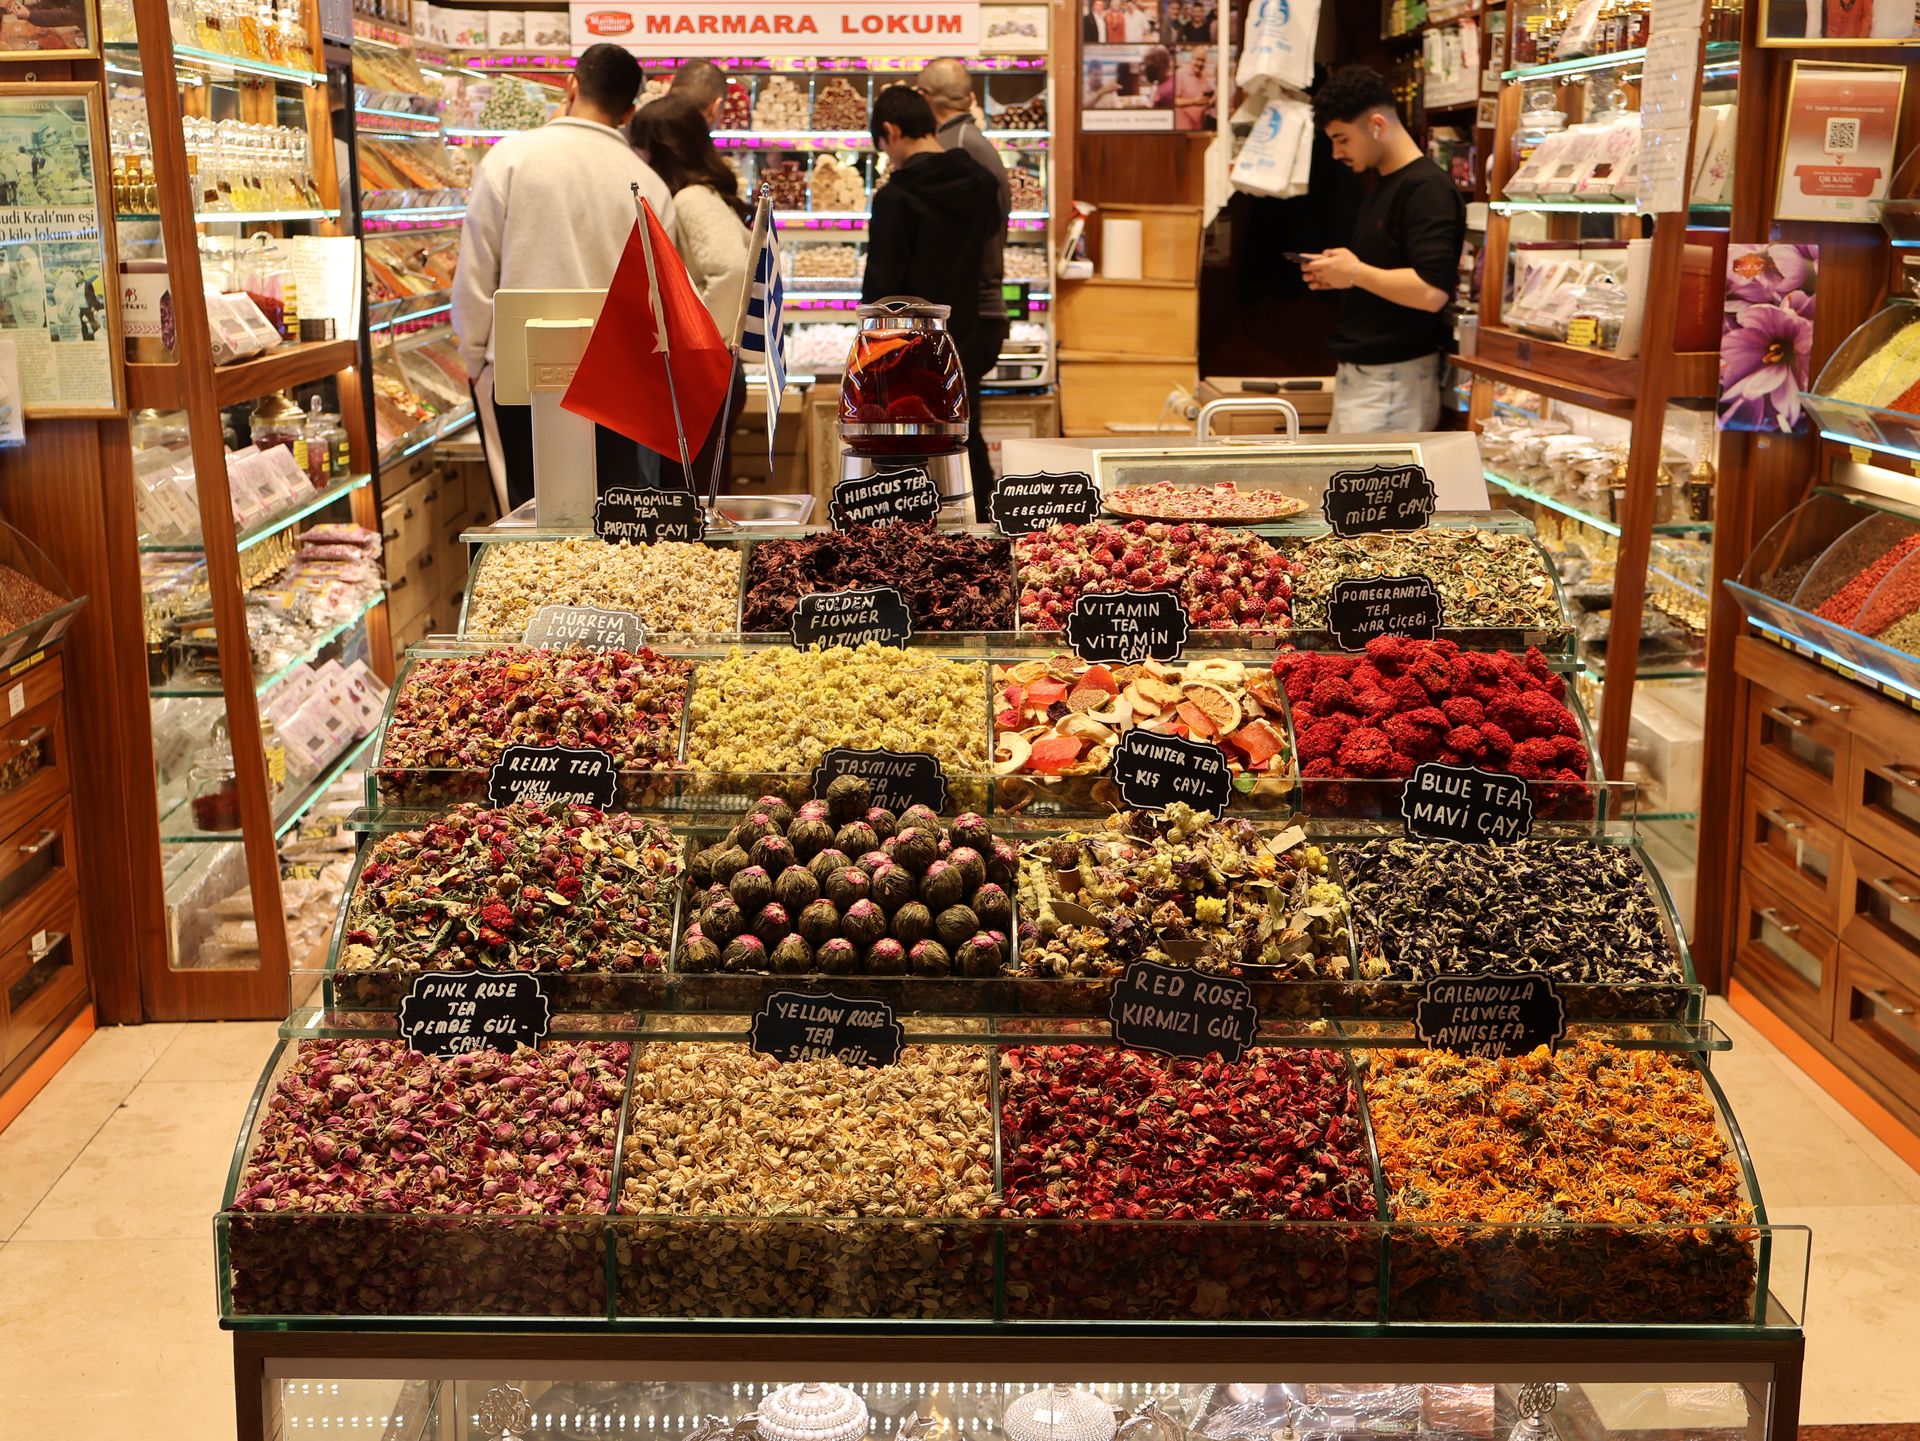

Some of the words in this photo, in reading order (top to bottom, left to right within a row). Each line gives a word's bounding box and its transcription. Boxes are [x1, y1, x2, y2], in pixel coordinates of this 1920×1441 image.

[646, 15, 818, 34] MARMARA
[841, 15, 962, 34] LOKUM
[9, 228, 31, 241] kilo
[35, 227, 73, 241] lokum
[844, 479, 901, 505] HIBISCUS
[903, 475, 927, 491] TEA
[1003, 483, 1054, 496] MALLOW
[1060, 483, 1083, 494] TEA
[1339, 472, 1411, 493] STOMACH
[1365, 490, 1394, 505] TEA
[634, 507, 659, 519] TEA
[603, 521, 648, 538] PAPATYA
[815, 595, 876, 612] GOLDEN
[1342, 585, 1429, 603] POMEGRANATE
[1083, 601, 1160, 618] VITAMIN
[1366, 603, 1390, 617] TEA
[810, 610, 879, 629] FLOWER
[1111, 619, 1139, 632] TEA
[546, 625, 590, 639] LOVE
[596, 630, 626, 645] TEA
[509, 757, 560, 772] RELAX
[569, 760, 602, 777] TEA
[1131, 741, 1186, 766] WINTER
[1193, 756, 1219, 775] TEA
[835, 759, 917, 777] JASMINE
[1421, 773, 1472, 798] BLUE
[1482, 783, 1521, 810] TEA
[1477, 812, 1519, 838] ÇAY
[422, 982, 467, 999] PINK
[474, 982, 517, 999] ROSE
[1135, 970, 1185, 997] RED
[1193, 982, 1247, 1011] ROSE
[1433, 982, 1534, 1004] CALENDULA
[448, 1001, 477, 1016] TEA
[776, 1002, 844, 1025] YELLOW
[846, 1009, 885, 1029] ROSE
[1452, 1004, 1520, 1023] FLOWER
[1122, 1002, 1199, 1035] KIRMIZI
[1207, 1014, 1242, 1042] GÜL
[805, 1027, 834, 1046] TEA
